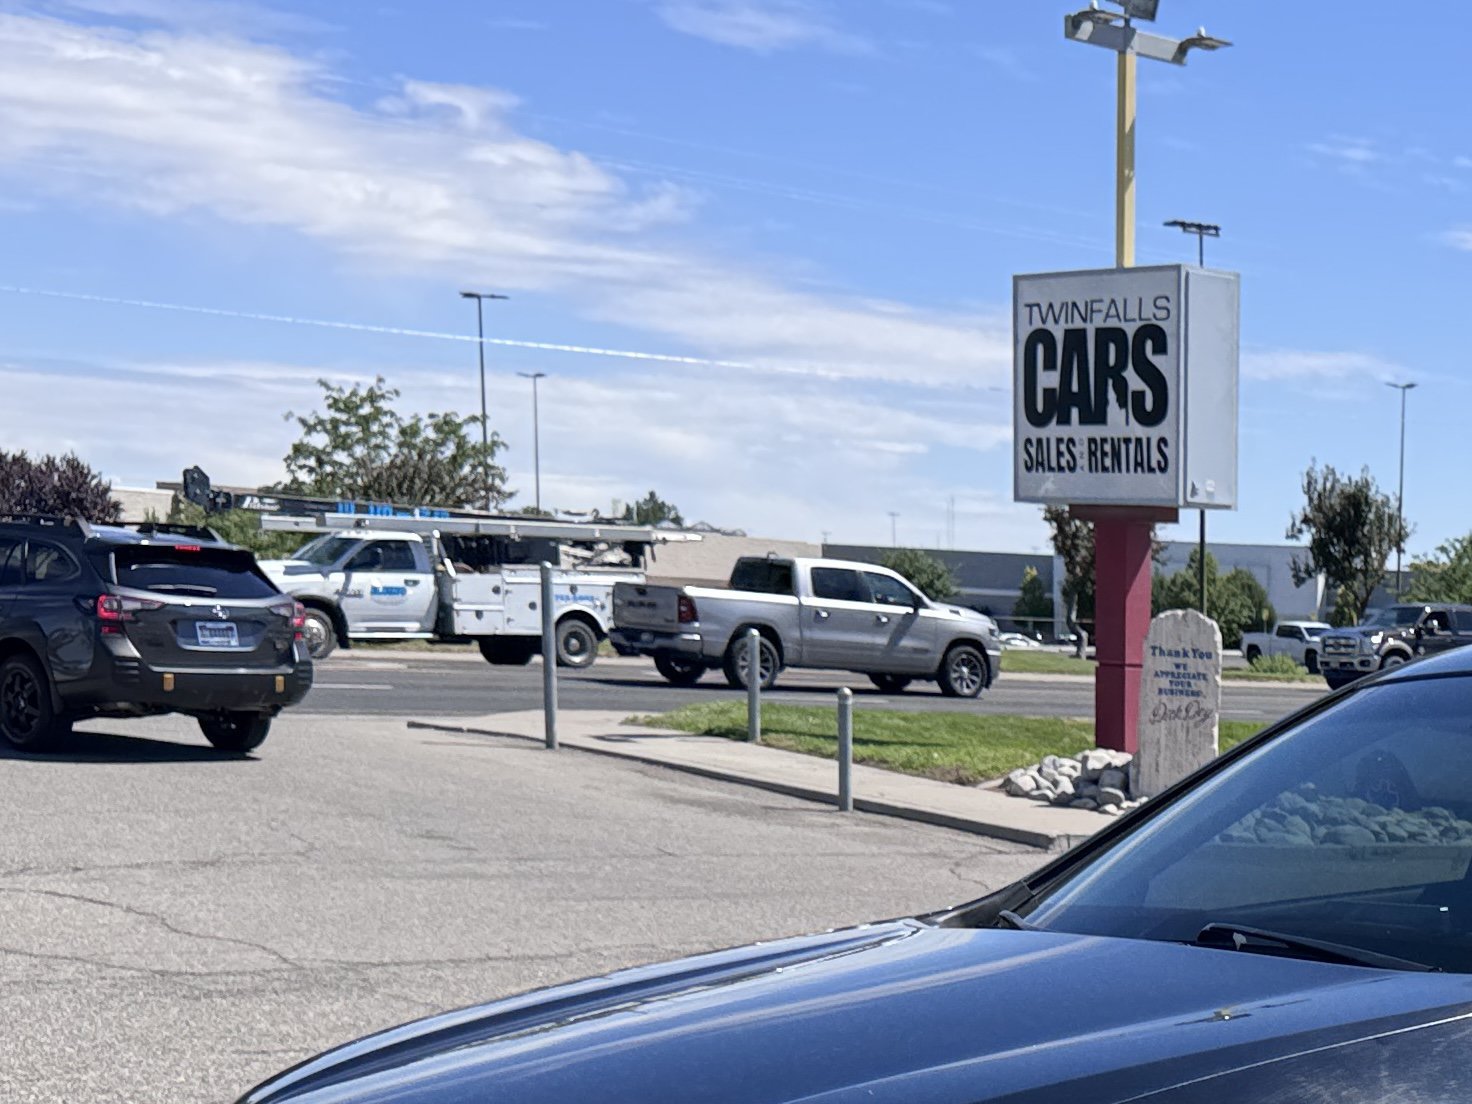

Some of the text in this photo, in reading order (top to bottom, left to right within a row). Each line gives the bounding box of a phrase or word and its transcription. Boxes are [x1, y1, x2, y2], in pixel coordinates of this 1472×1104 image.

[1024, 323, 1169, 428] CARS
[1024, 436, 1078, 474] SALES
[1087, 436, 1170, 474] RENTALS
[1150, 645, 1213, 660] Thank You
[1173, 663, 1188, 671] WE
[1169, 680, 1193, 688] YOUR
